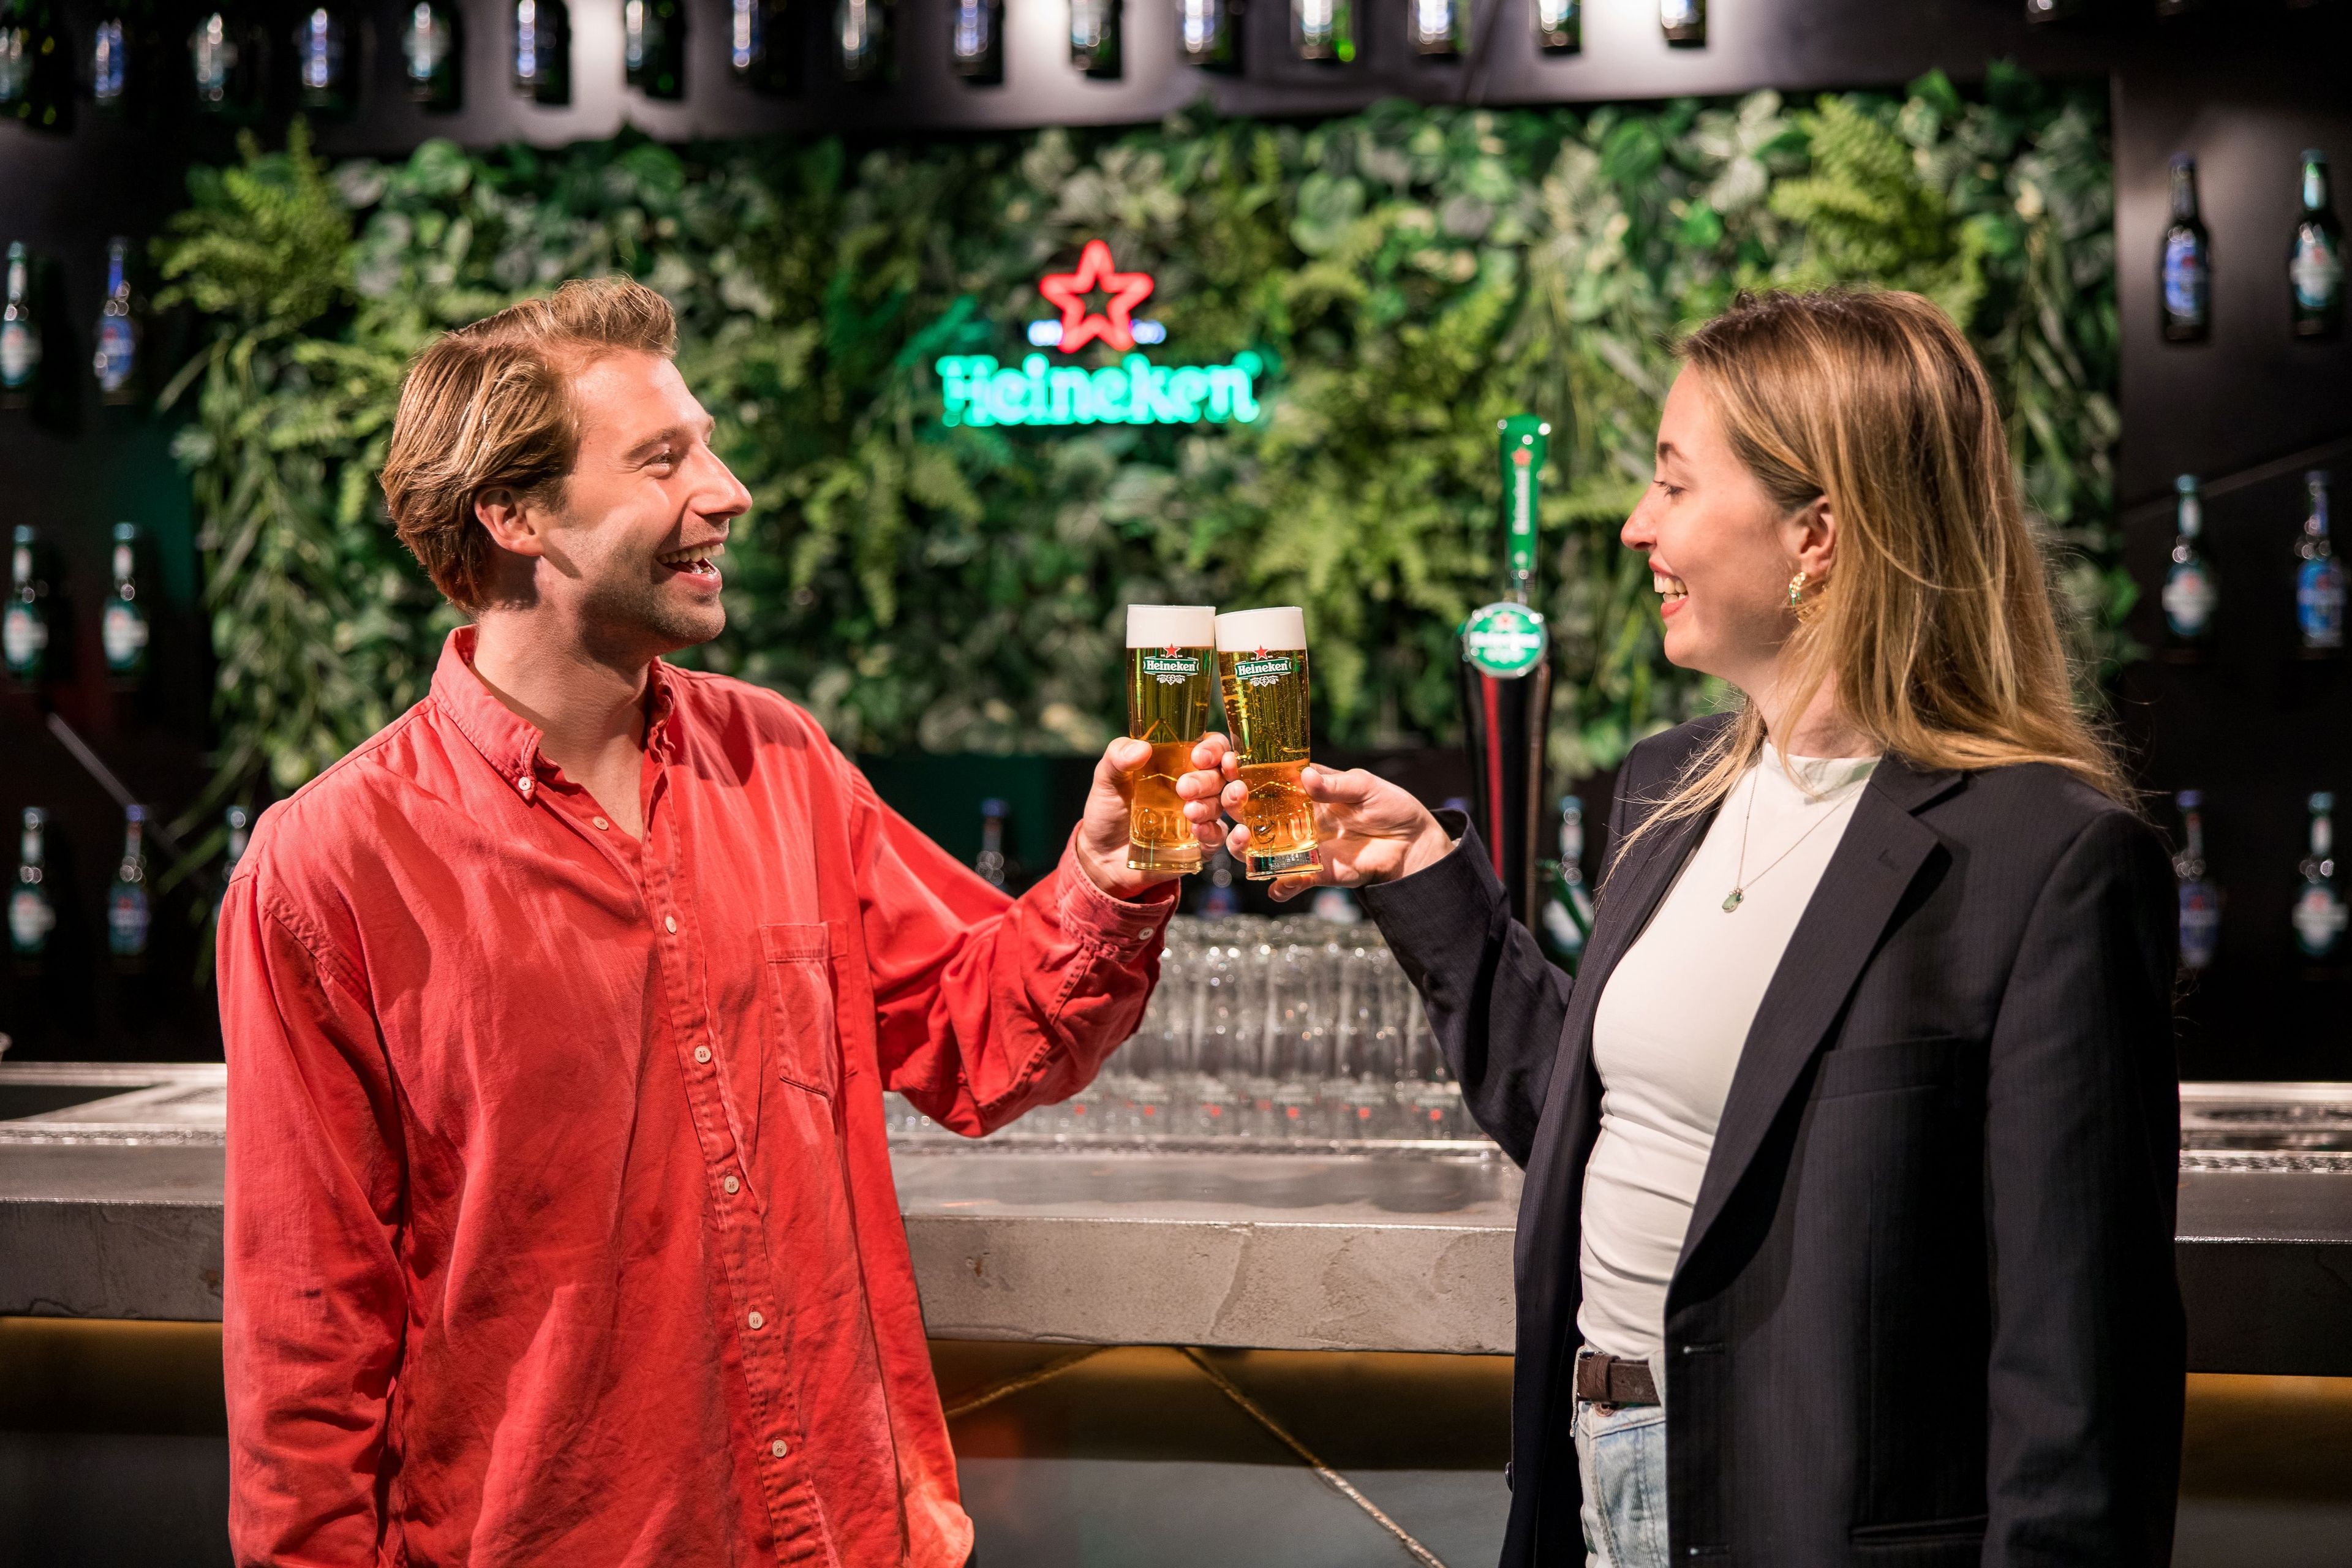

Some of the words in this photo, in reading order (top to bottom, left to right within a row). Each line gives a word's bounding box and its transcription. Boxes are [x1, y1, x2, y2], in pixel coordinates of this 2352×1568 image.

[937, 352, 1262, 426] Heineken
[1146, 660, 1196, 671] Heineken
[1237, 661, 1288, 676] Heineken
